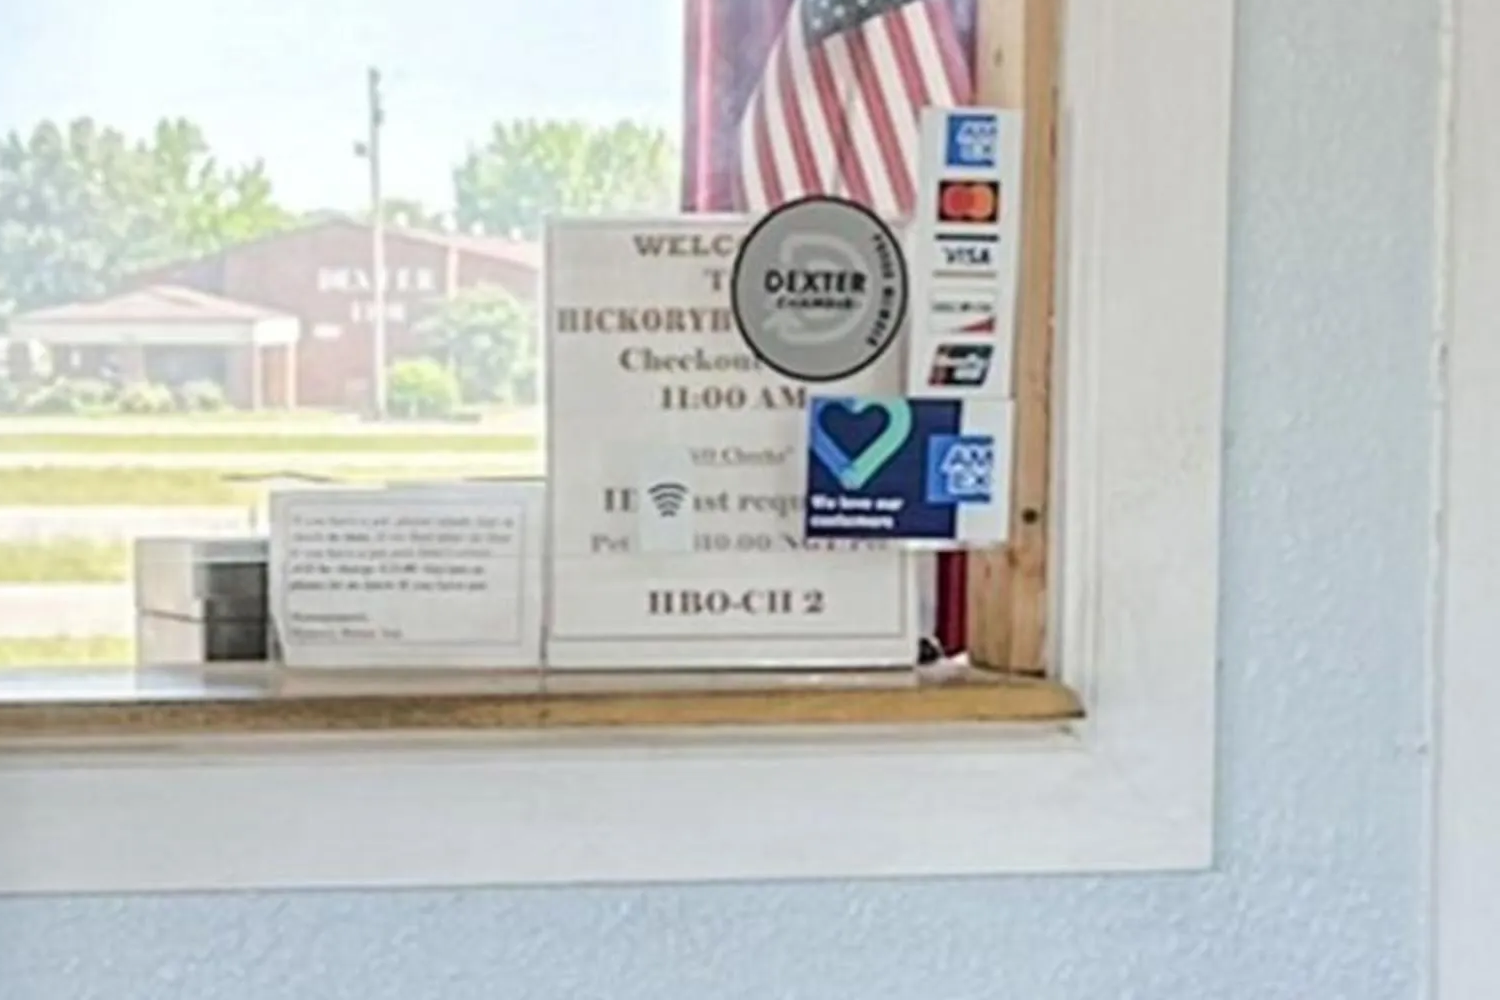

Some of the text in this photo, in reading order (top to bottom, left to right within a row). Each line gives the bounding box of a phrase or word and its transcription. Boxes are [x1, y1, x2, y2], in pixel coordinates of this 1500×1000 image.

[633, 235, 734, 257] WELC
[942, 248, 990, 265] VISA
[764, 269, 867, 294] DEXTER
[556, 307, 732, 333] HICKORYH
[661, 386, 807, 410] 11:00 AM
[803, 591, 825, 614] 2
